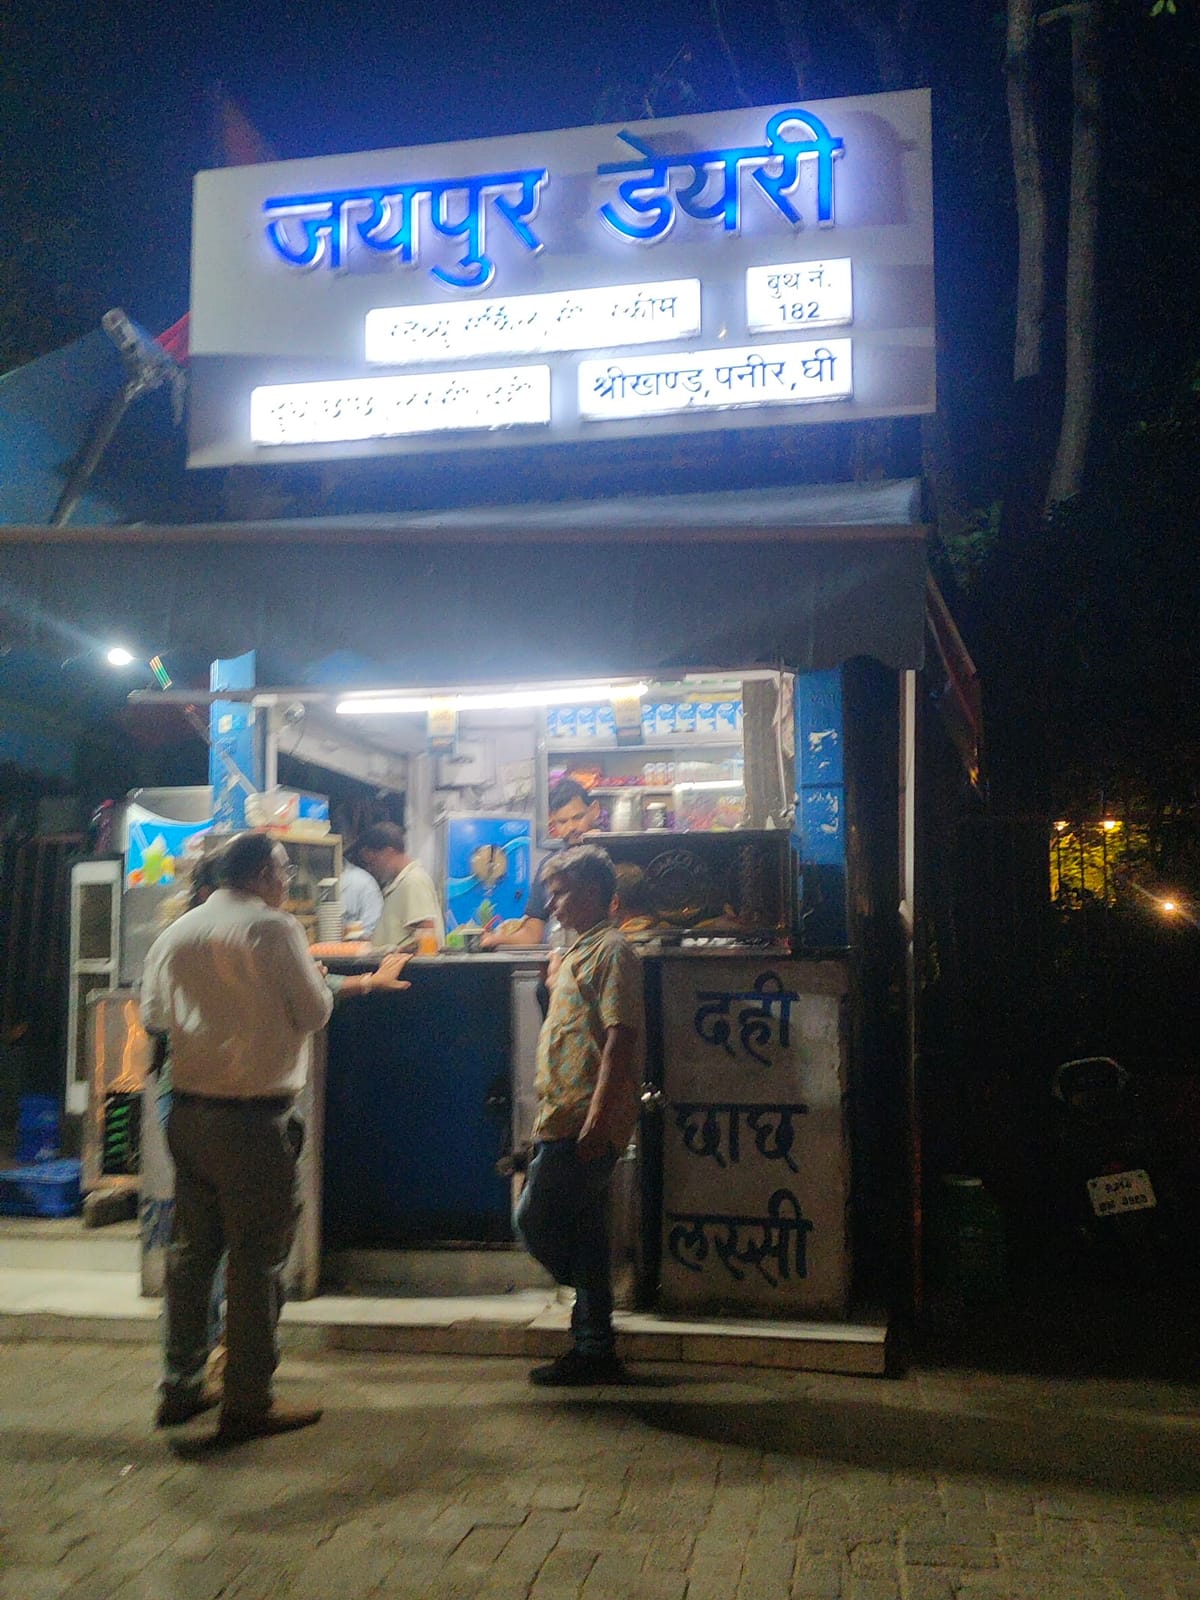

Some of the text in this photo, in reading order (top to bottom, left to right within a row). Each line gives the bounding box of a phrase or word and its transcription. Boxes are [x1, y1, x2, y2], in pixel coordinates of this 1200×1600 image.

[263, 108, 845, 292] जयपुर डेयरी
[779, 301, 821, 320] 182
[808, 264, 832, 288] नं.
[801, 348, 838, 382] घी
[695, 970, 800, 1068] दही
[674, 1103, 809, 1173] छाछ
[667, 1188, 814, 1288] लस्सी
